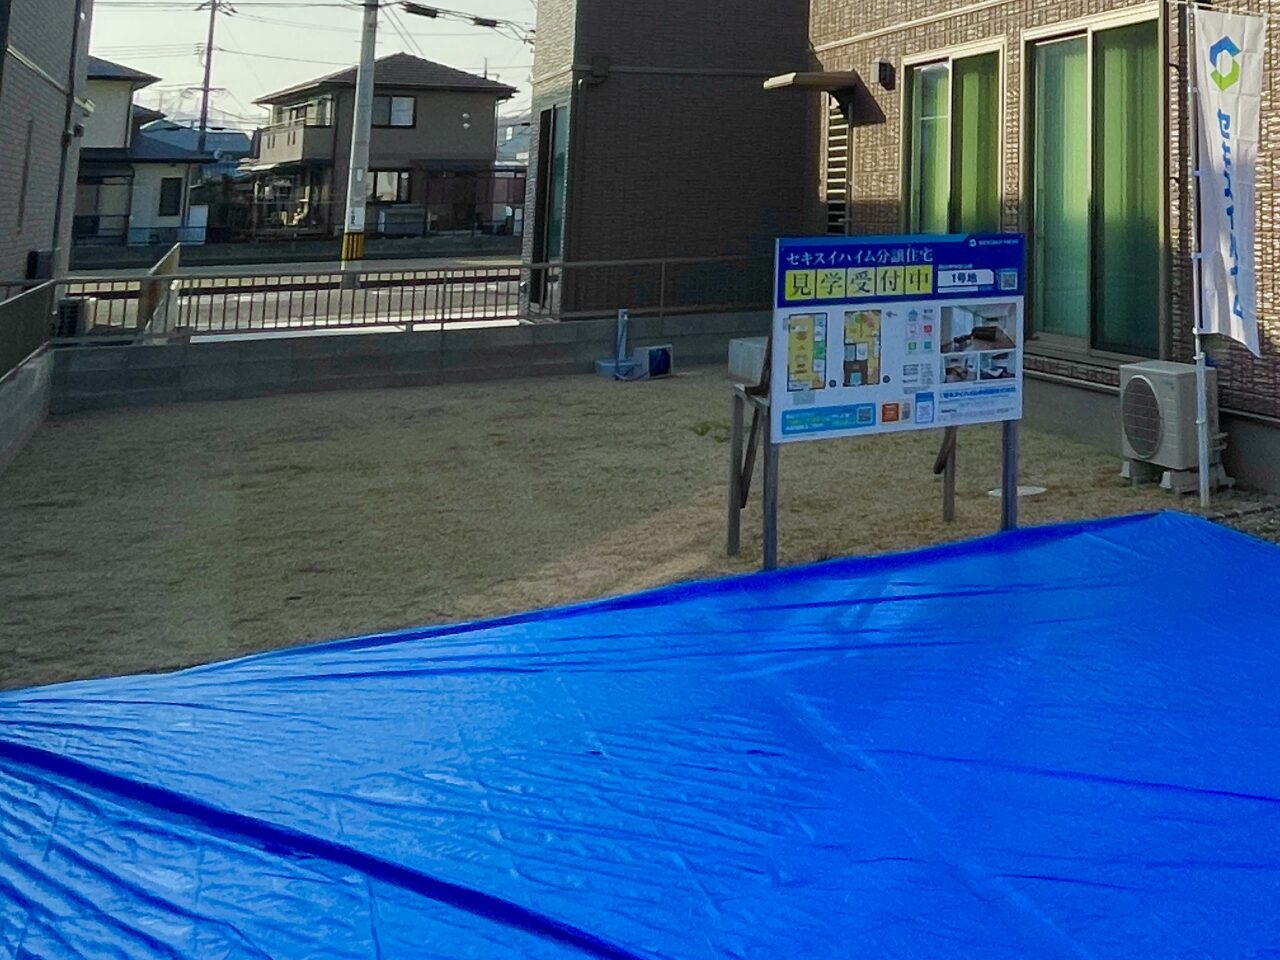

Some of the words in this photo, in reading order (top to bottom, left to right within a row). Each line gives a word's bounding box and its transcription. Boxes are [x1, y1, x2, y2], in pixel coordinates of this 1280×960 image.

[786, 247, 933, 266] セキスイハイム分譲住宅
[790, 269, 929, 297] 見学受付中
[952, 272, 977, 283] 1号地
